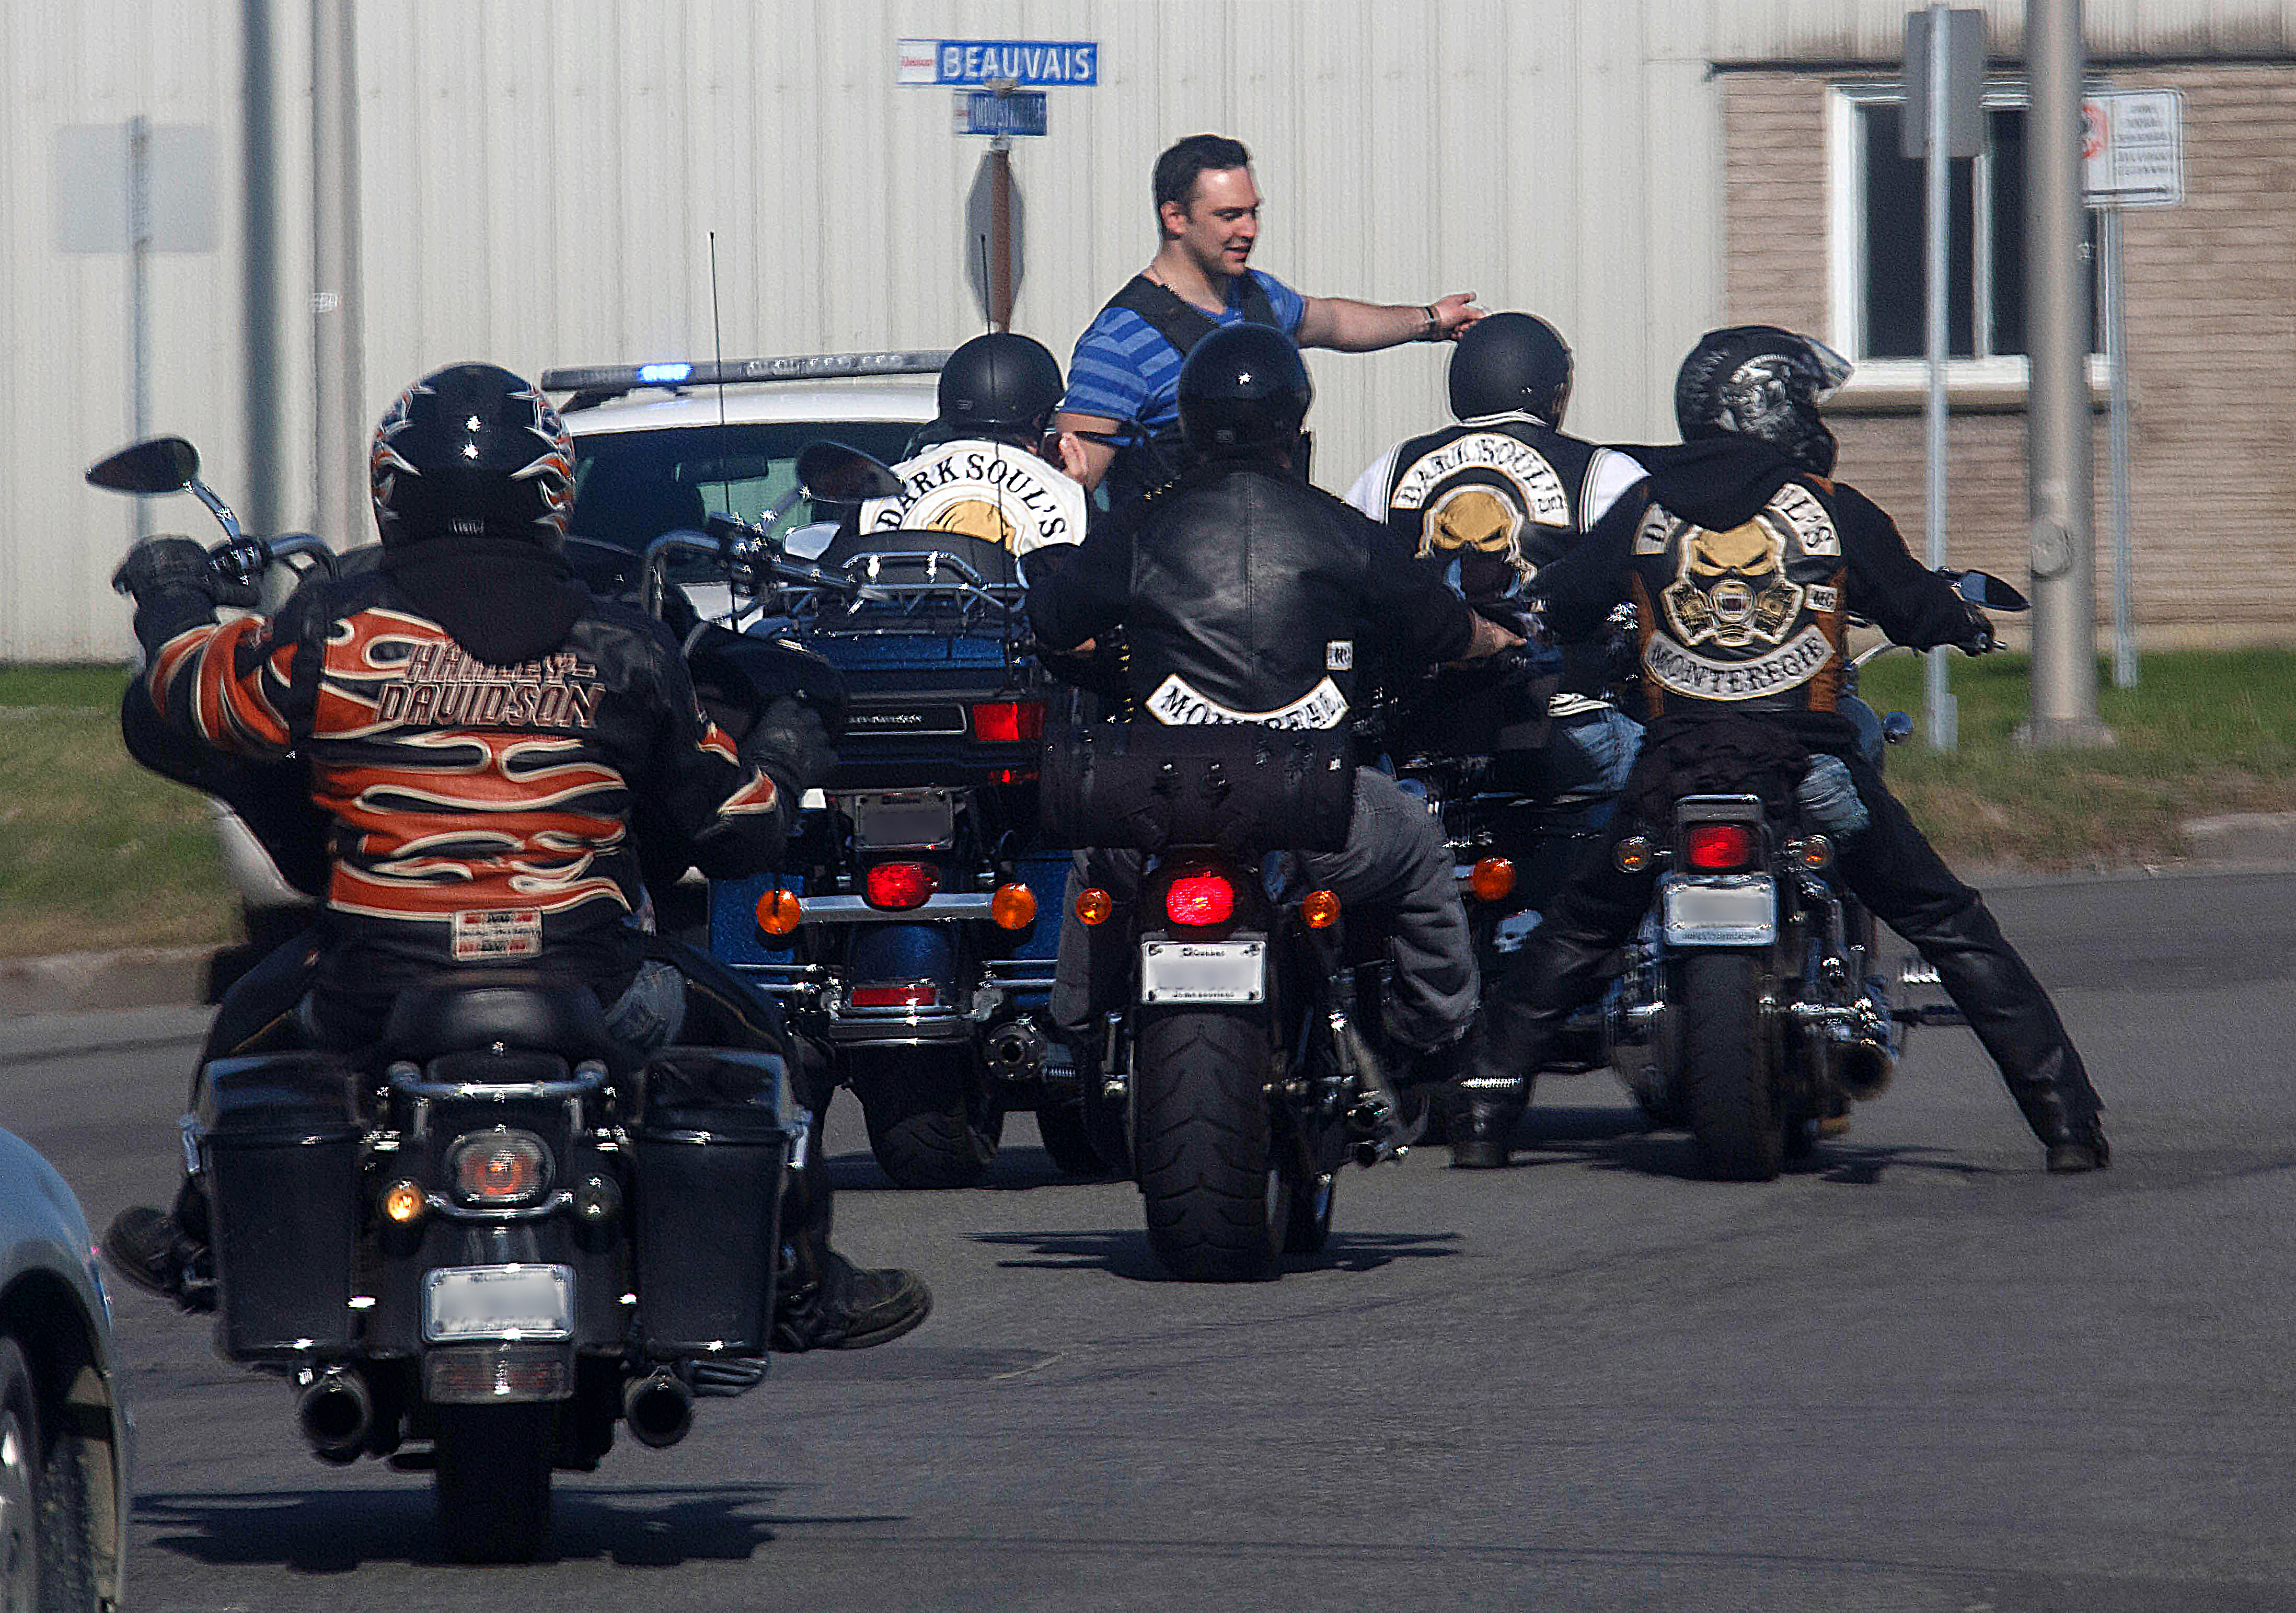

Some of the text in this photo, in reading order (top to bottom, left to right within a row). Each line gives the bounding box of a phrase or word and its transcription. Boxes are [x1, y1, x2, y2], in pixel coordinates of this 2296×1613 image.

[943, 46, 1090, 80] BEAUVAIS
[875, 453, 1067, 538] DARK SOUL'S
[376, 681, 607, 729] DAVIDSON
